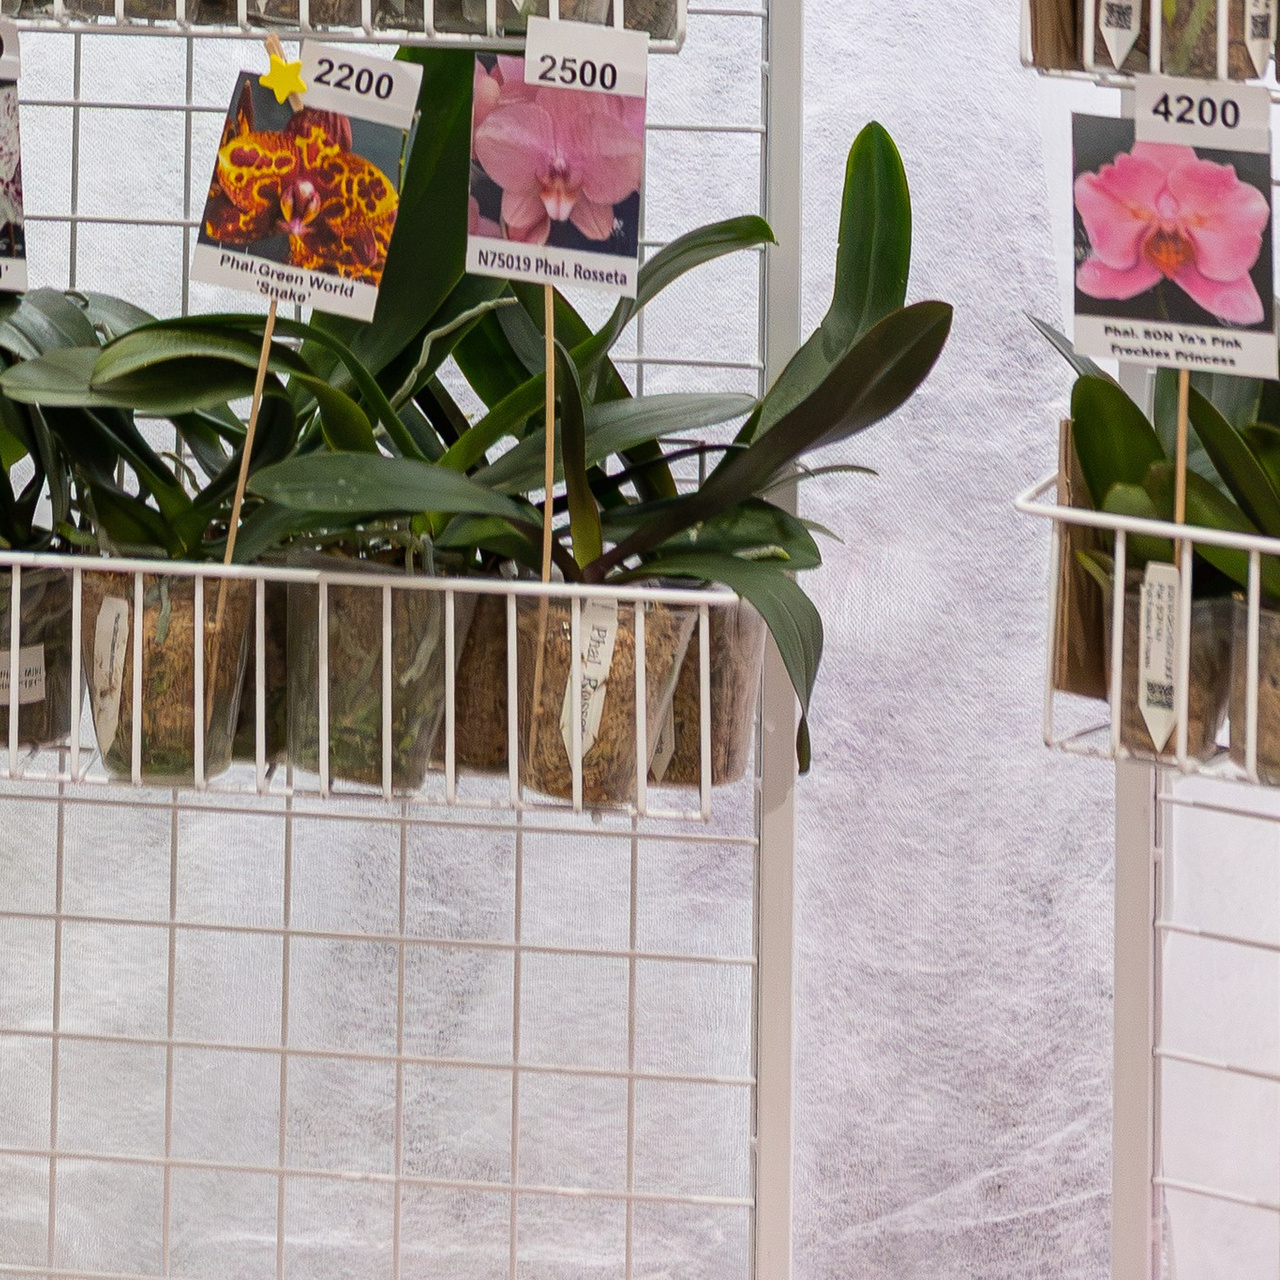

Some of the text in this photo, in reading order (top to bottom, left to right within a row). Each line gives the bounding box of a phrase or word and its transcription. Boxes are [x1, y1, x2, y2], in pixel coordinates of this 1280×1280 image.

[313, 58, 394, 100] 2200
[538, 54, 618, 91] 2500
[1151, 93, 1241, 129] 4200
[477, 250, 628, 286] N75019 Phal. Rosseta
[256, 280, 312, 303] 'Snake'
[309, 275, 355, 298] World
[1144, 329, 1173, 342] SON
[1211, 336, 1243, 350] Pink
[1111, 344, 1236, 366] Freckles Princess
